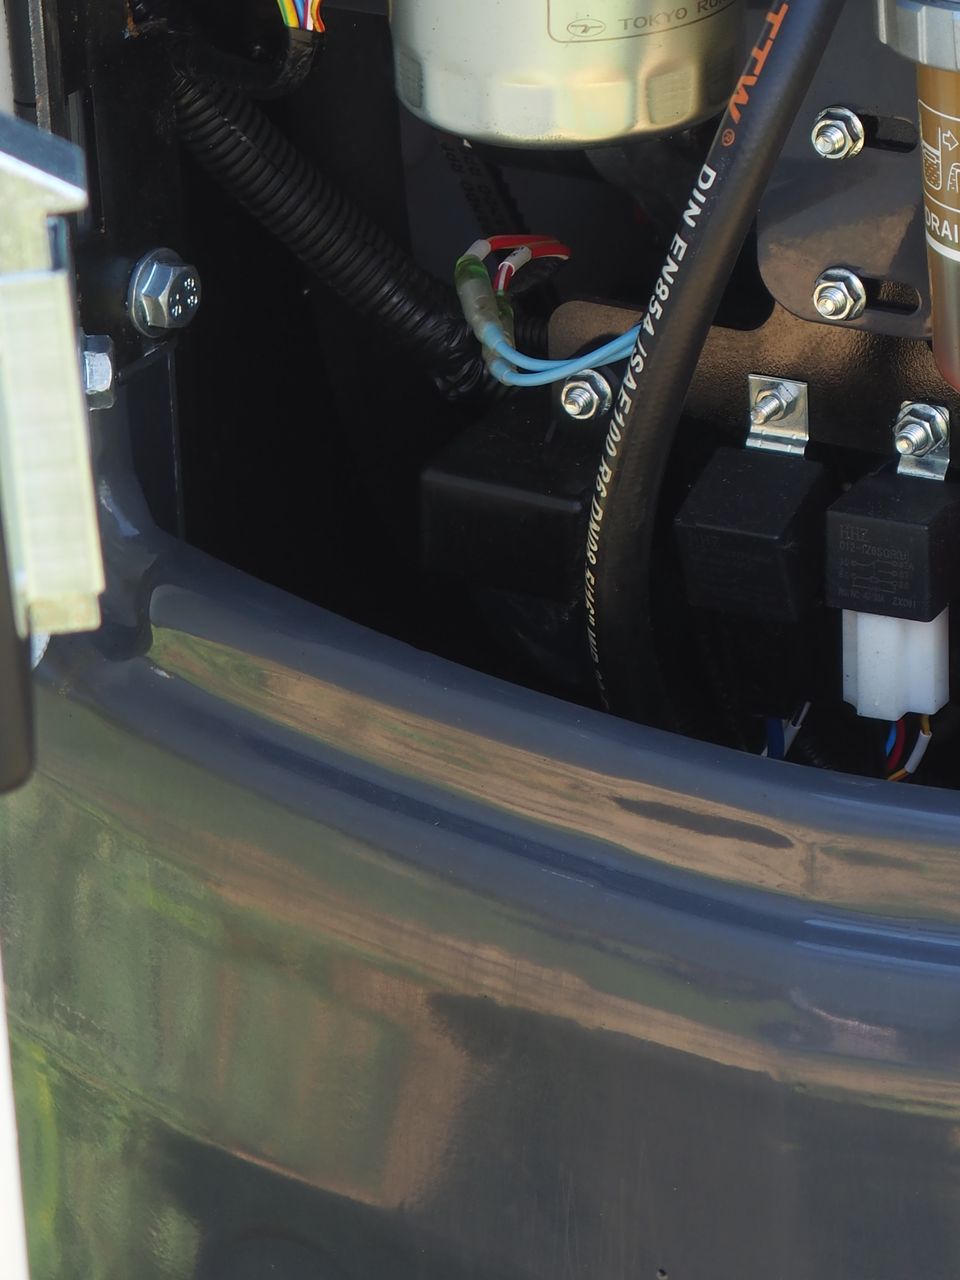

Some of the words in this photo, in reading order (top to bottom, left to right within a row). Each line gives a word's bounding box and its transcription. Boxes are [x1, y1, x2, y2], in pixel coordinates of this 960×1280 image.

[617, 6, 689, 31] TOKYO
[682, 163, 717, 228] DIN
[642, 232, 688, 336] EN854
